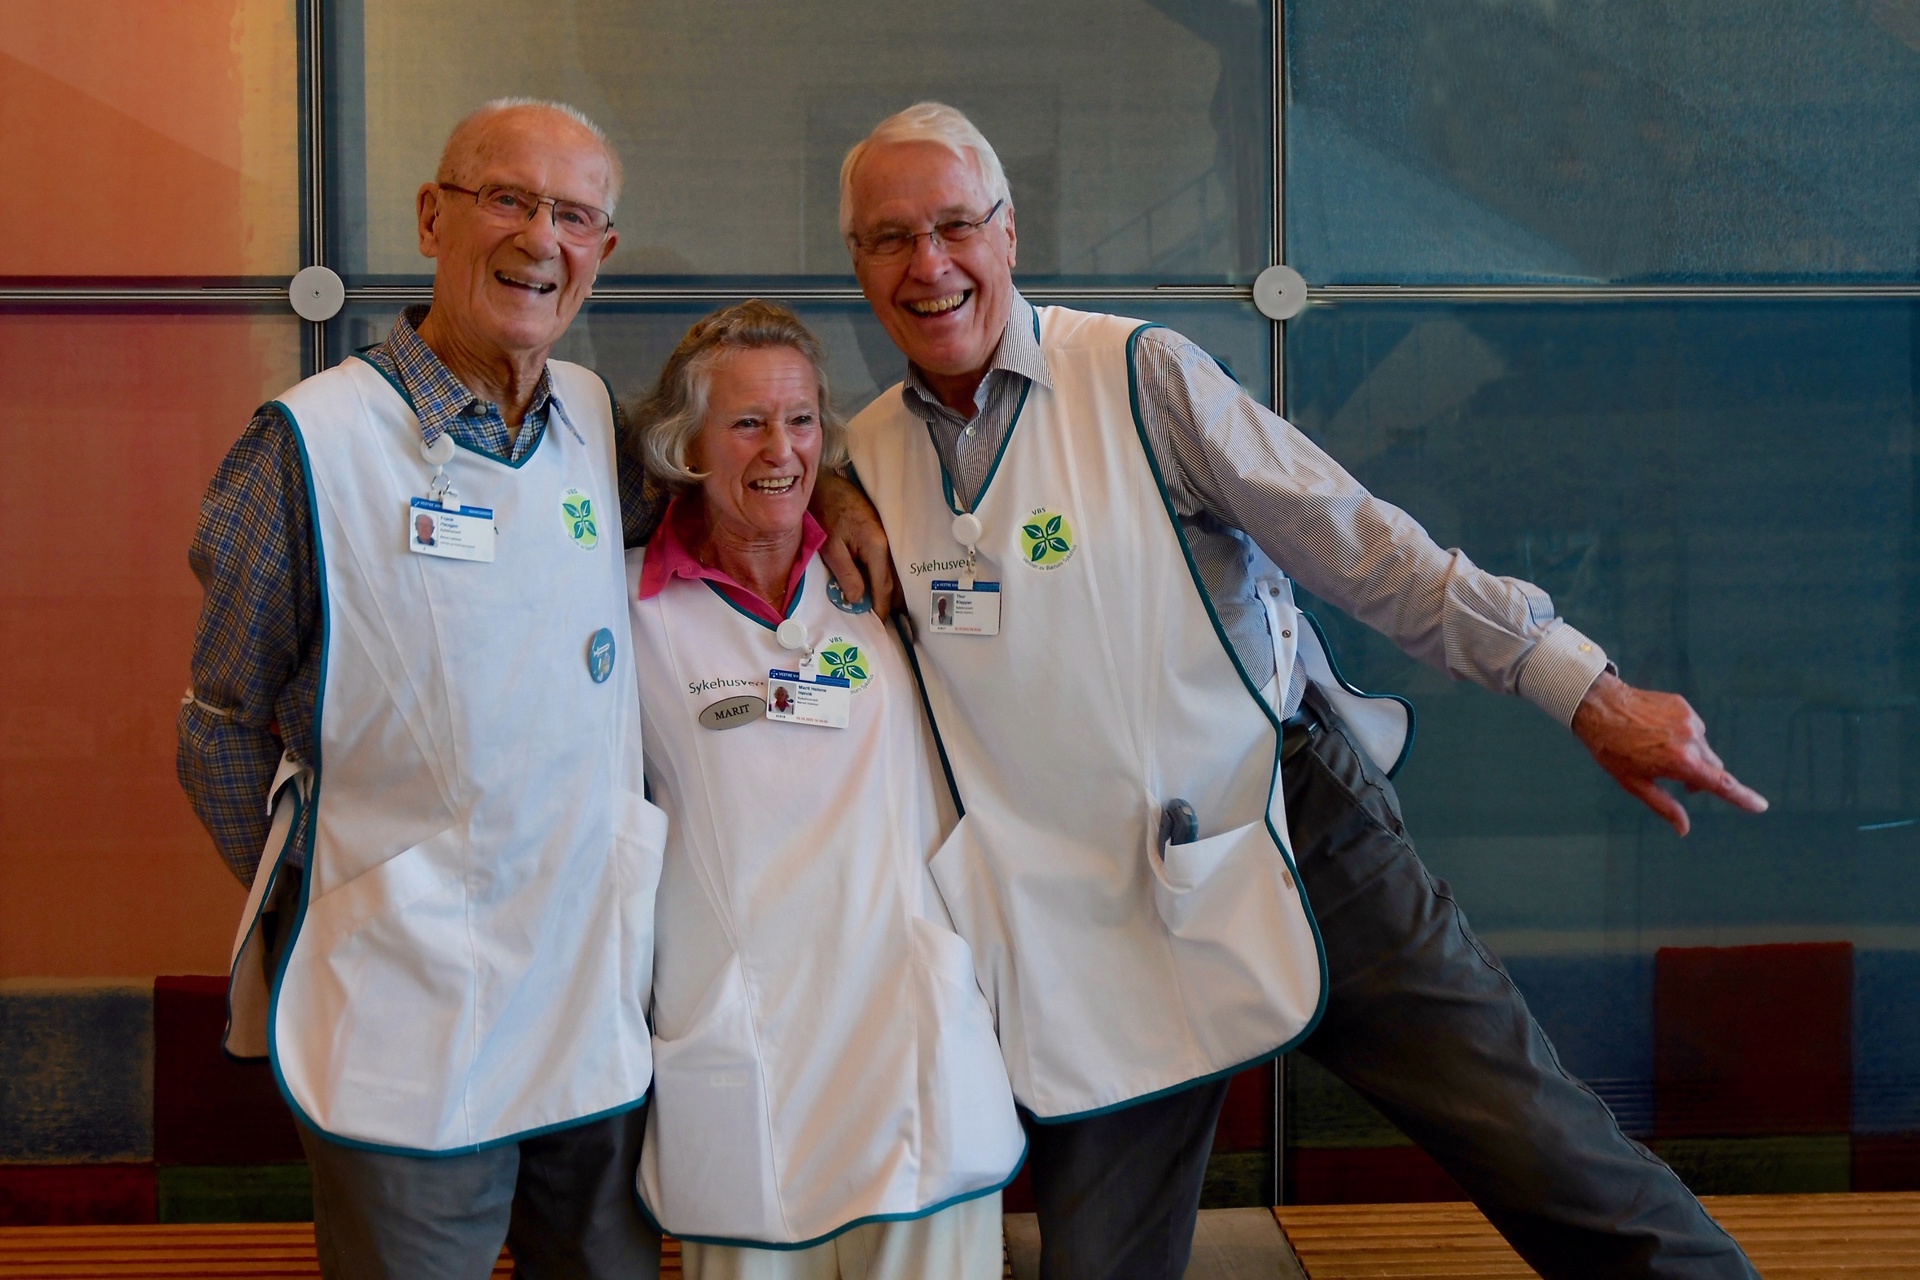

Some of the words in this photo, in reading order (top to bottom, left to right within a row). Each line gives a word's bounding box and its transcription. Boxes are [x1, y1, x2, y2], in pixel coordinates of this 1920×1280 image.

[1031, 506, 1047, 515] VBS
[910, 559, 976, 576] Sykehusver
[828, 636, 844, 644] VBS
[714, 703, 750, 720] MARIT
